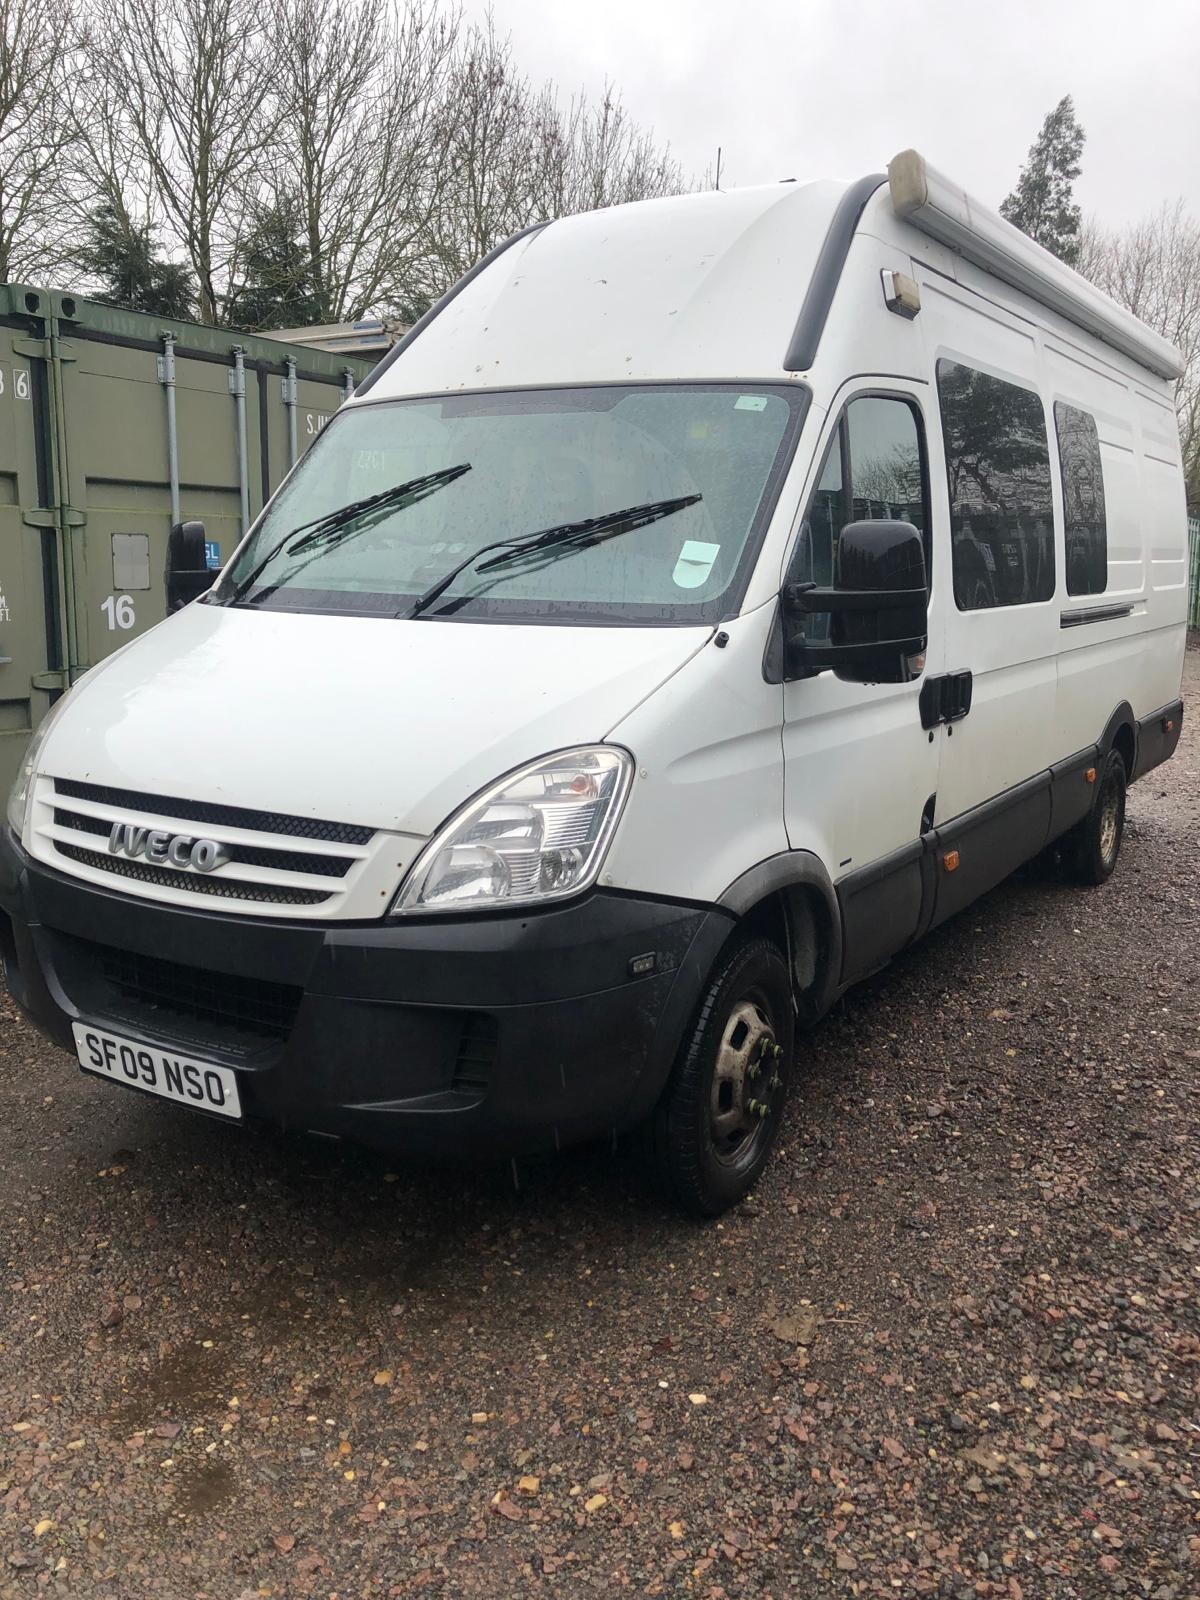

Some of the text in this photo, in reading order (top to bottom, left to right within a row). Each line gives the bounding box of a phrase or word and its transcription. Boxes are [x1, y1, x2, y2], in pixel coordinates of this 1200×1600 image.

[100, 594, 136, 631] 16
[107, 822, 230, 873] IVECO
[85, 1032, 226, 1108] SF09 NSO
